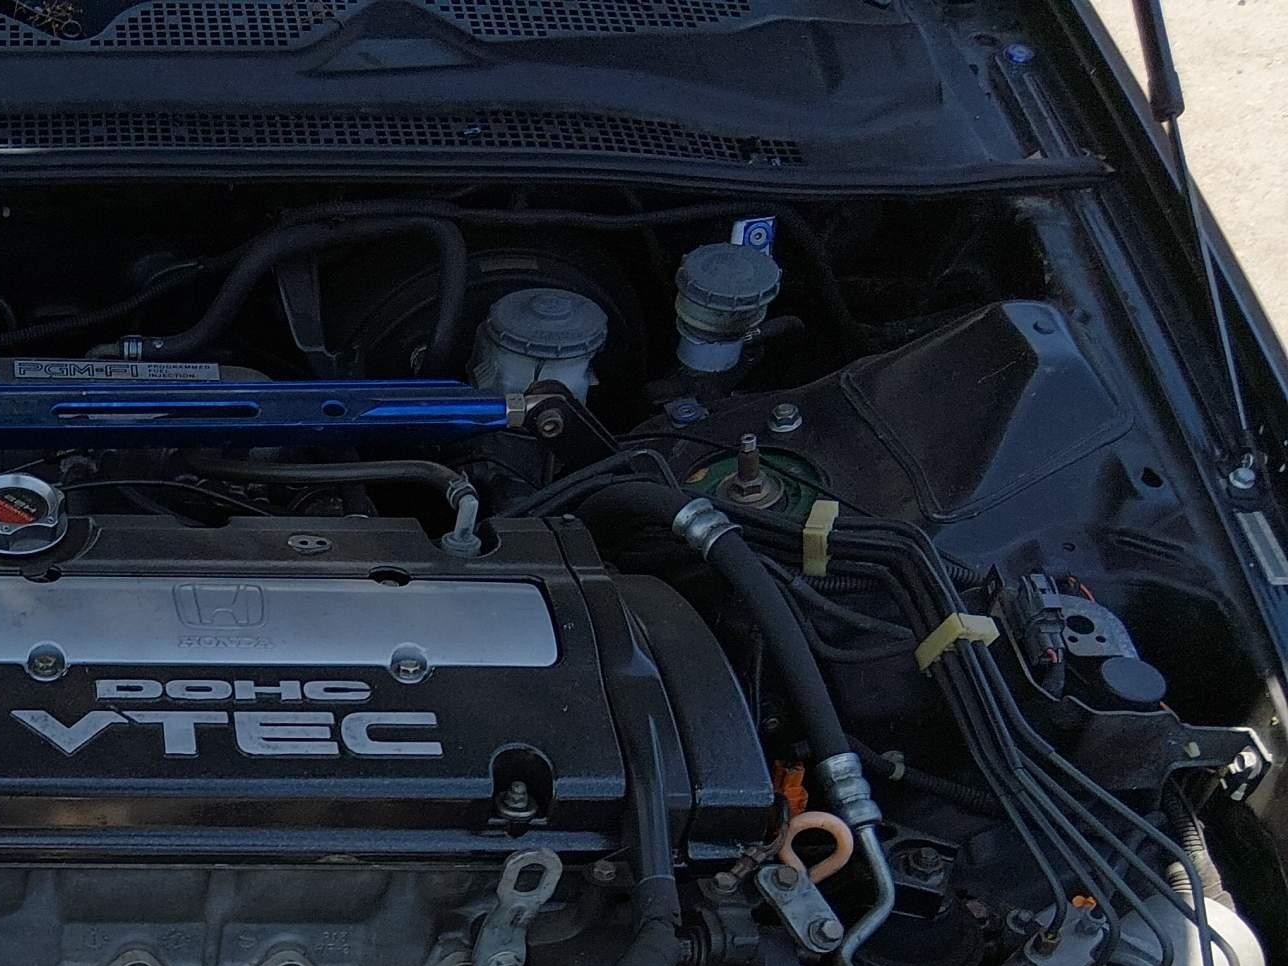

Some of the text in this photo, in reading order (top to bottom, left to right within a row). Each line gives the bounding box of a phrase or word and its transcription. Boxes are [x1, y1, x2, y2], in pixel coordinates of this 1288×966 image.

[18, 362, 139, 378] PGM-FI
[178, 635, 273, 649] HONDA
[95, 679, 373, 701] DOHC
[10, 709, 443, 758] VTEC
